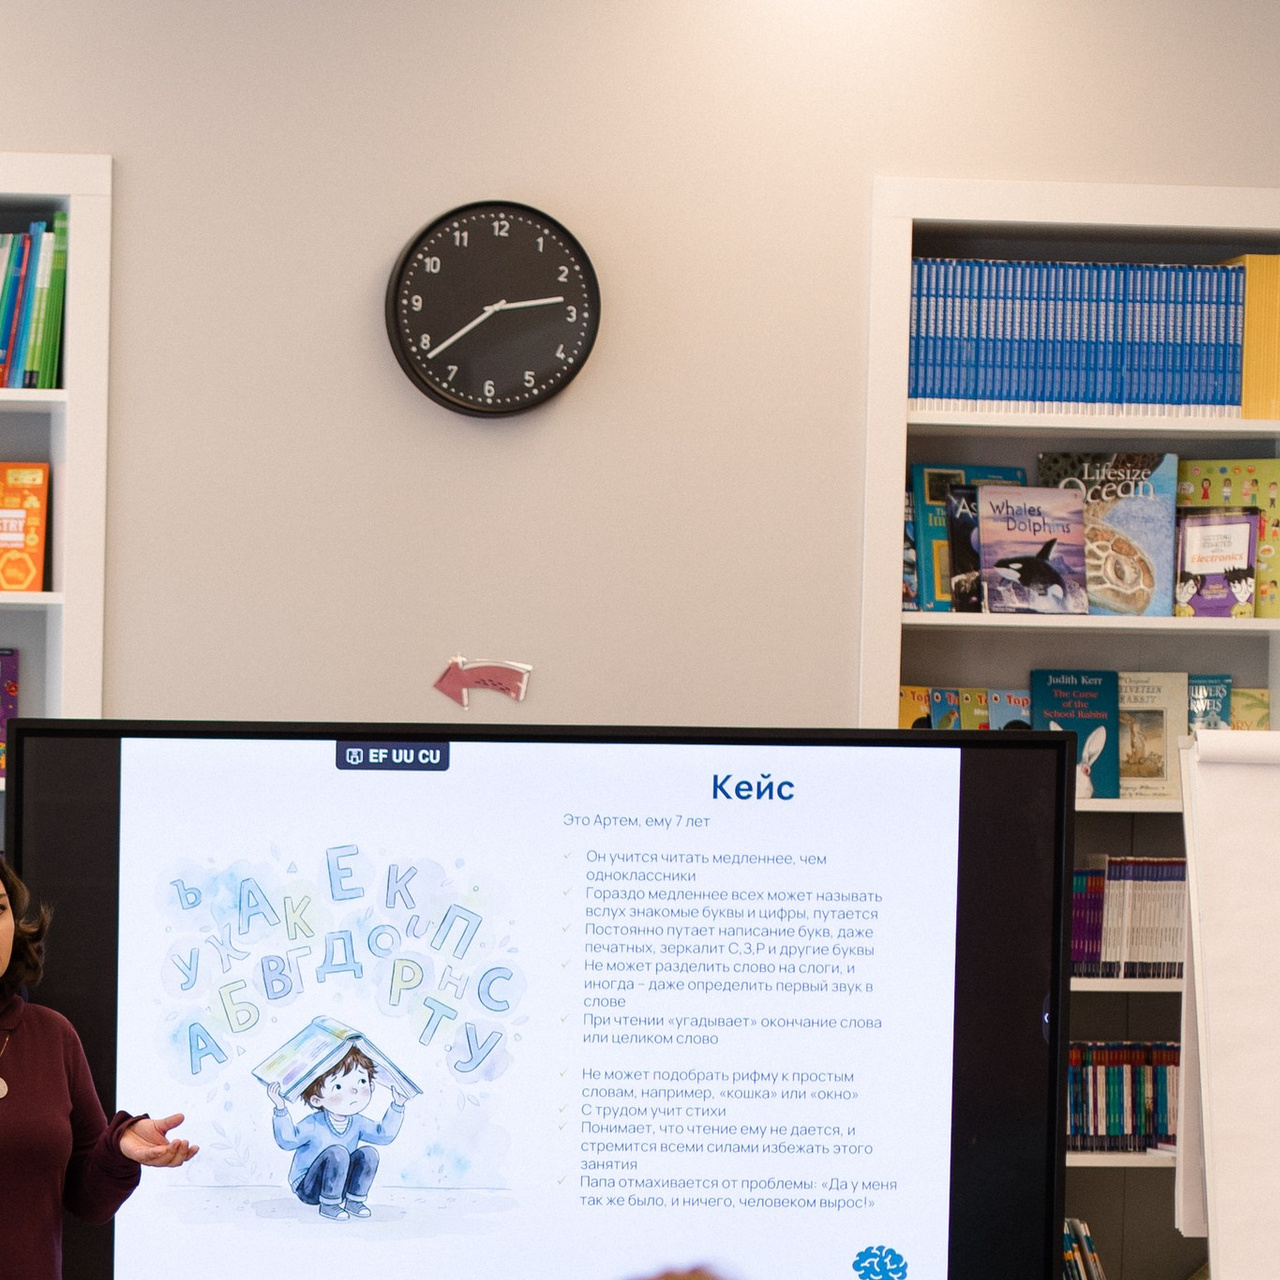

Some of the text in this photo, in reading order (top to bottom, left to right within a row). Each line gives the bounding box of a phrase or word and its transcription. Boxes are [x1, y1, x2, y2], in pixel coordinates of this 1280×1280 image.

[491, 220, 510, 237] 12
[453, 231, 468, 247] 11
[536, 236, 545, 253] 1
[424, 256, 441, 274] 10
[557, 265, 568, 282] 2
[411, 295, 423, 311] 9
[566, 306, 577, 322] 3
[420, 334, 431, 350] 8
[555, 344, 566, 361] 4
[447, 365, 459, 381] 7
[524, 371, 535, 387] 5
[483, 380, 495, 397] 6
[1082, 462, 1151, 480] Lifesize
[1059, 477, 1155, 502] Ocean
[989, 499, 1042, 517] Whales
[1006, 516, 1071, 536] Dolphins
[1191, 552, 1244, 563] Electronics
[1047, 675, 1103, 686] Judith Kerr
[368, 748, 441, 764] EF UU CU
[712, 772, 796, 802] Кейс
[563, 812, 711, 831] Это Артем, ему 7 лет
[586, 849, 827, 867] Он учится читать медленнее, чем
[585, 870, 697, 884] одноклассники
[585, 887, 883, 904] Гораздо медленнее всех может называть
[585, 905, 879, 923] вслух знакомые буквы и цифры, путается
[585, 923, 874, 942] Постоянно путает написание букв, даже
[584, 943, 656, 955] печатных,
[659, 943, 726, 958] зеркалит
[768, 945, 777, 955] и
[778, 944, 830, 959] другие
[831, 943, 875, 960] буквы
[584, 958, 856, 976] Не может разделить слово на слоги, и
[584, 978, 874, 996] иногда даже определить первый звук в
[583, 996, 627, 1008] слове
[583, 1012, 882, 1031] При чтении «угадывает» окончание слова
[582, 1032, 719, 1045] или целиком слово
[582, 1067, 855, 1087] Не может подобрать рифму к простым
[581, 1087, 859, 1103] словам, например, «кошка» или «окно»
[580, 1102, 727, 1121] С трудом учит стихи
[581, 1121, 856, 1139] Понимает, что чтение ему не дается, и
[580, 1141, 874, 1157] стремится всеми силами избежать этого
[580, 1160, 638, 1172] занятия
[580, 1174, 898, 1194] Папа отмахивается от проблемы: «Да у меня
[579, 1193, 876, 1212] так же было, и ничего, человеком вырос!»
